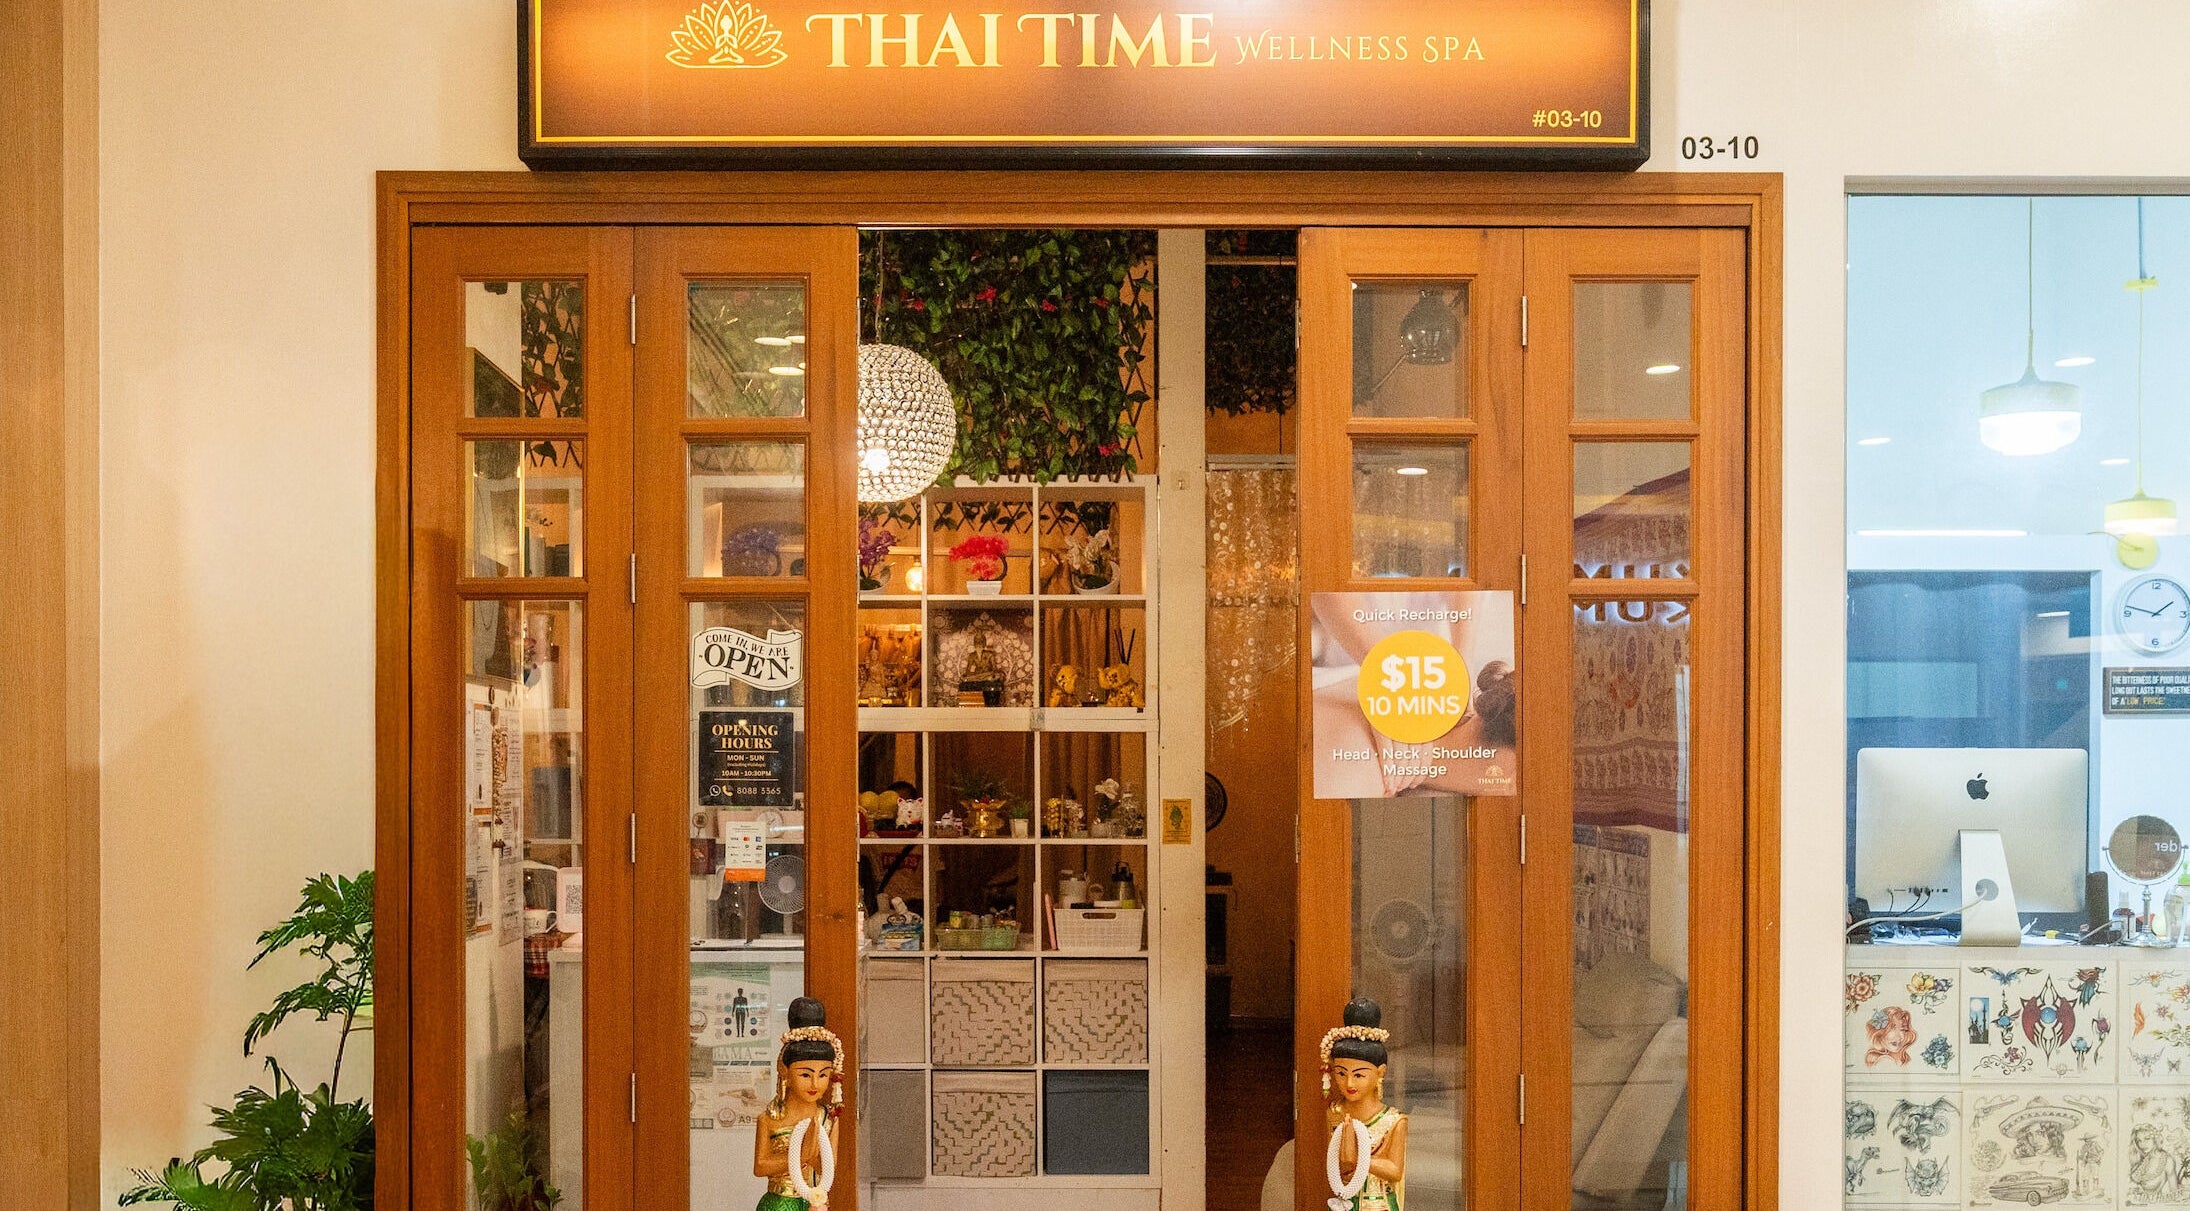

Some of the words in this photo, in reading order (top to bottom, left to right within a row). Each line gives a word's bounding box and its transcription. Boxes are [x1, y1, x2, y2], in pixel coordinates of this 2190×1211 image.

[805, 13, 1003, 68] THAI
[1016, 12, 1217, 68] TIME
[1234, 29, 1408, 64] WELLNESS
[1422, 34, 1485, 63] SPA
[1532, 109, 1602, 129] #03-10
[1681, 136, 1760, 161] 03-10
[2151, 582, 2161, 590] 12
[1352, 608, 1395, 623] Quick
[1399, 607, 1472, 622] Recharge!
[706, 634, 733, 644] COME
[751, 643, 765, 655] WE
[768, 646, 789, 657] ARE
[704, 643, 790, 680] OPEN
[1381, 654, 1446, 692] $15
[1366, 696, 1391, 716] 10
[1397, 695, 1461, 716] MINS
[711, 724, 779, 736] OPENING
[721, 737, 773, 749] HOURS
[1332, 748, 1370, 761] Head
[1382, 748, 1420, 760] Neck
[1432, 746, 1497, 760] Shoulder
[1383, 764, 1447, 778] Massage
